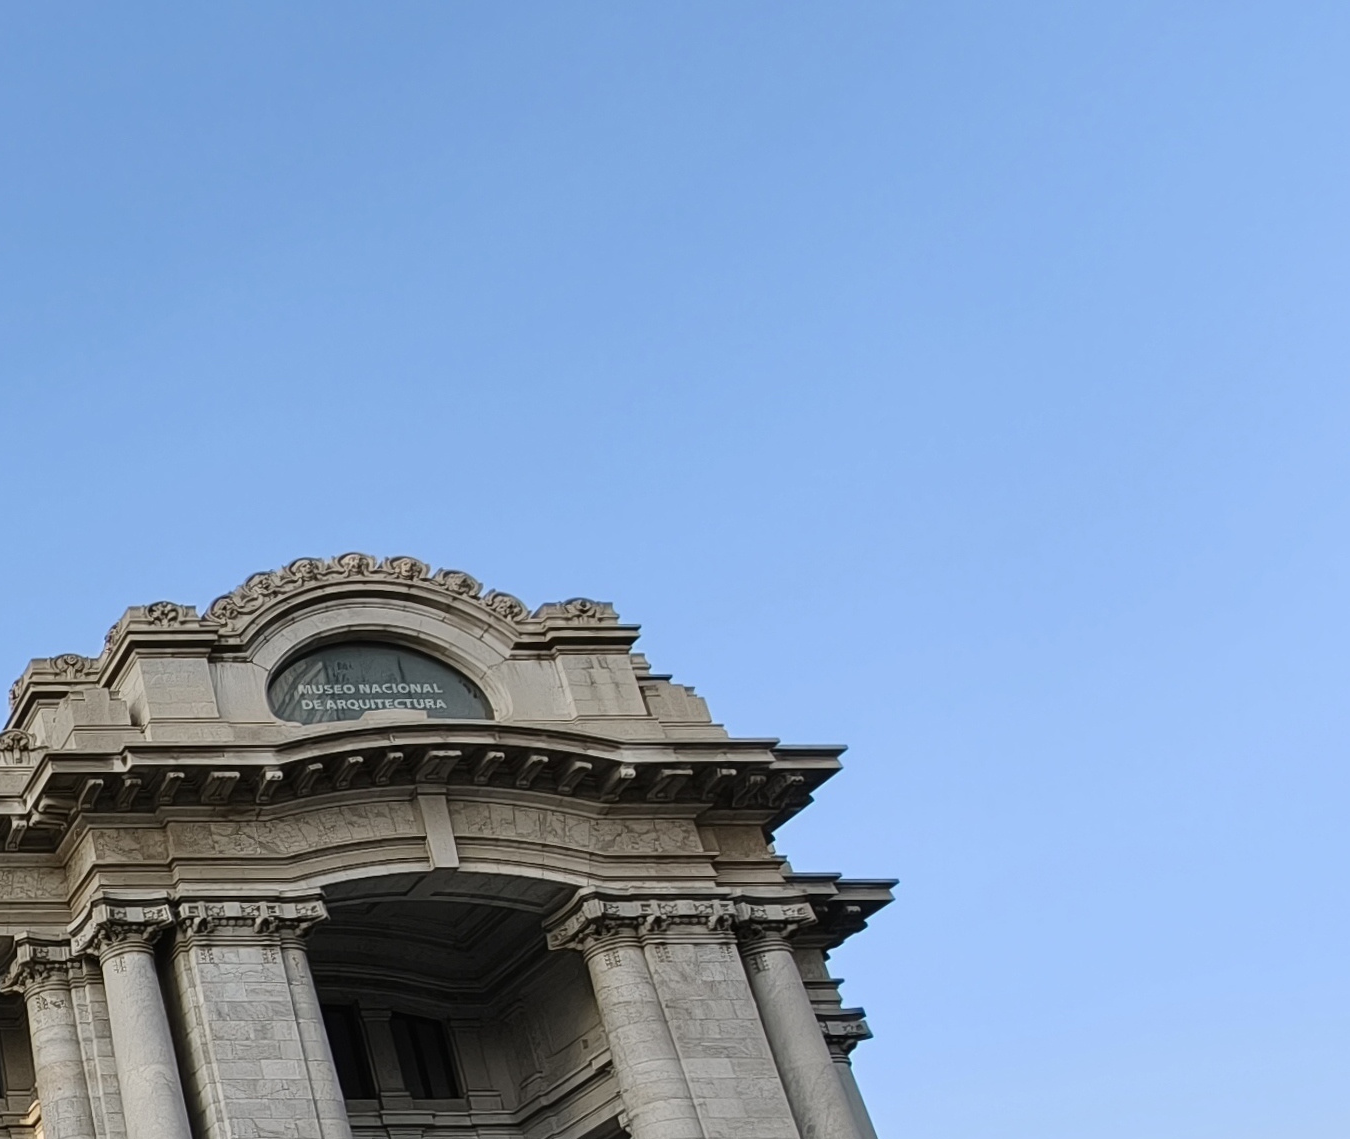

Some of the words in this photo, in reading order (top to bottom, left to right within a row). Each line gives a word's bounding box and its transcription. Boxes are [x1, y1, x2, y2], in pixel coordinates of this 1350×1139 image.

[298, 684, 355, 694] MUSEO
[359, 683, 443, 693] NACIONAL
[301, 699, 322, 710] DE
[326, 699, 446, 710] ARQUITECTURA
